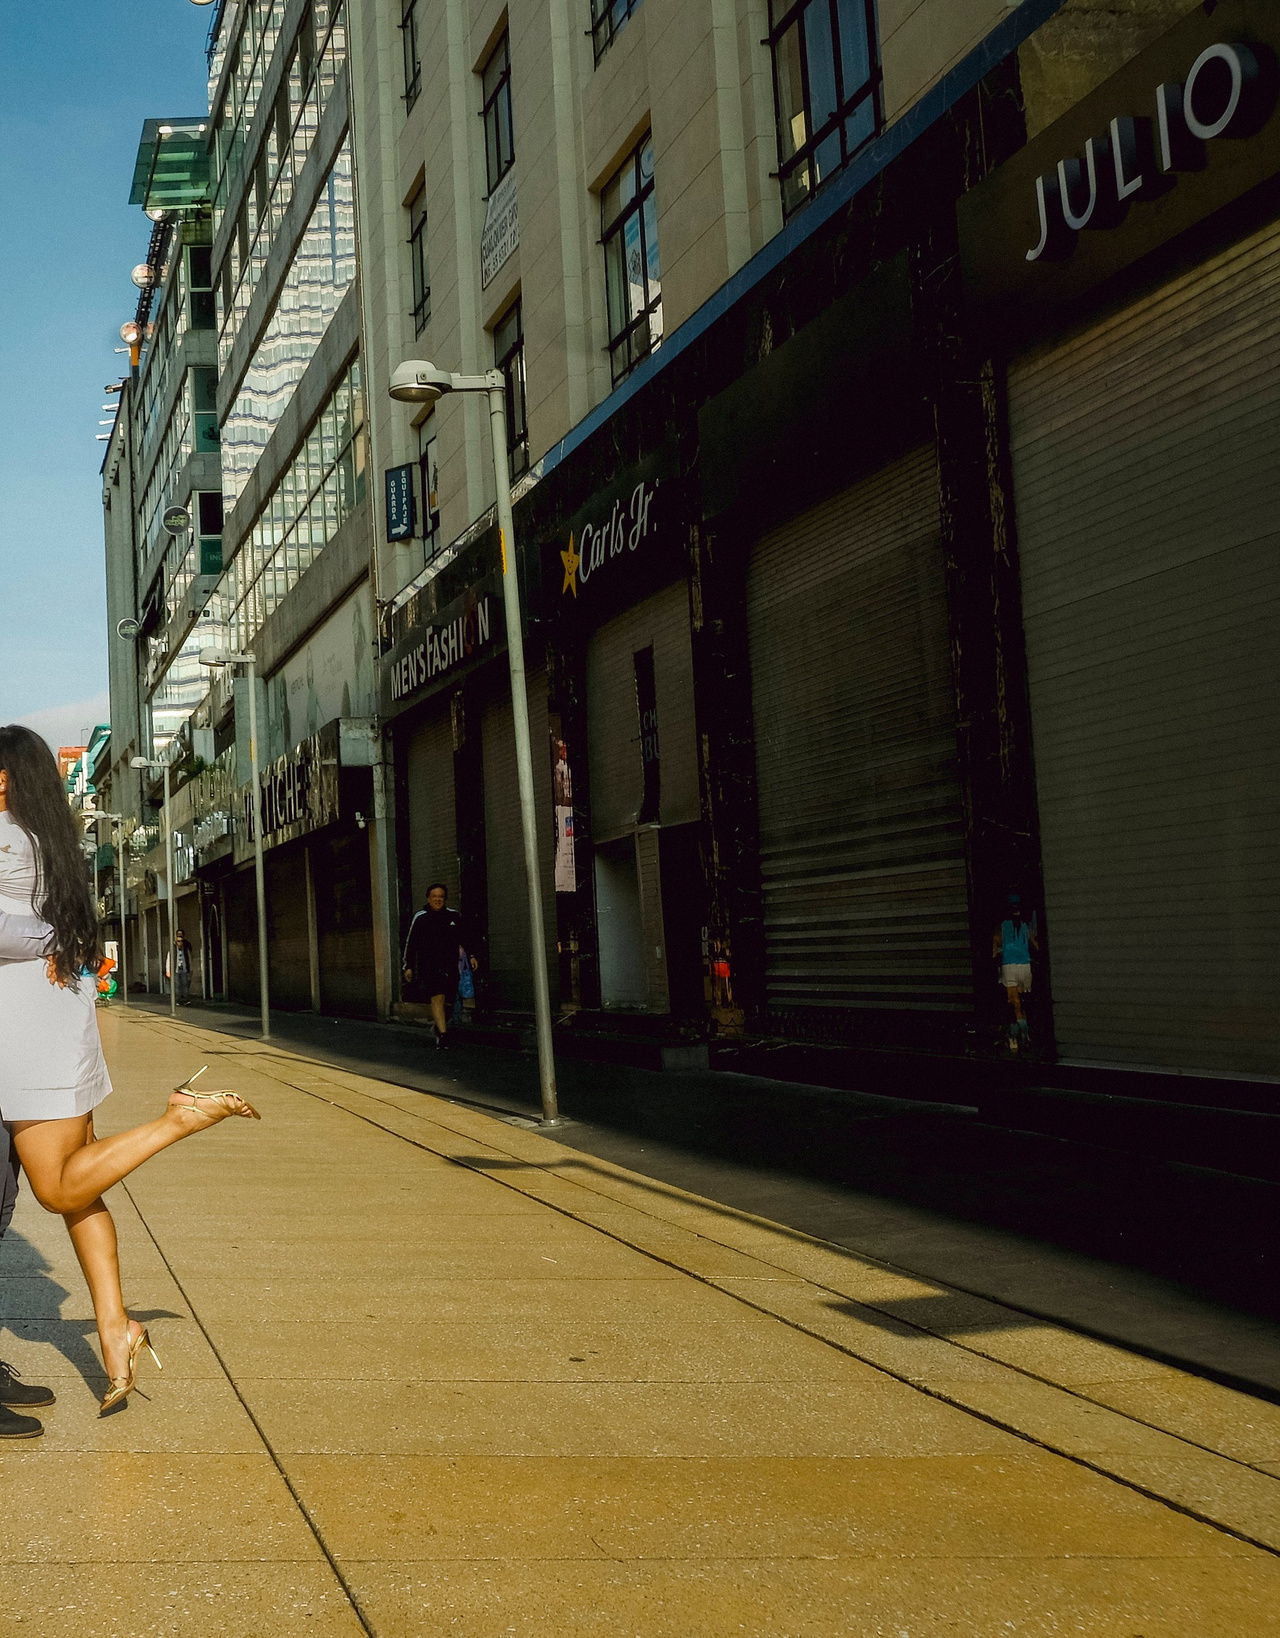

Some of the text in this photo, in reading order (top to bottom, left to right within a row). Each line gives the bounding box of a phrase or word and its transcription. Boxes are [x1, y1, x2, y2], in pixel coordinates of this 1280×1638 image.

[1025, 43, 1243, 261] JULIO
[579, 499, 625, 583] Carl's
[628, 482, 657, 551] Jr.
[391, 597, 490, 701] MEN'S FASHION
